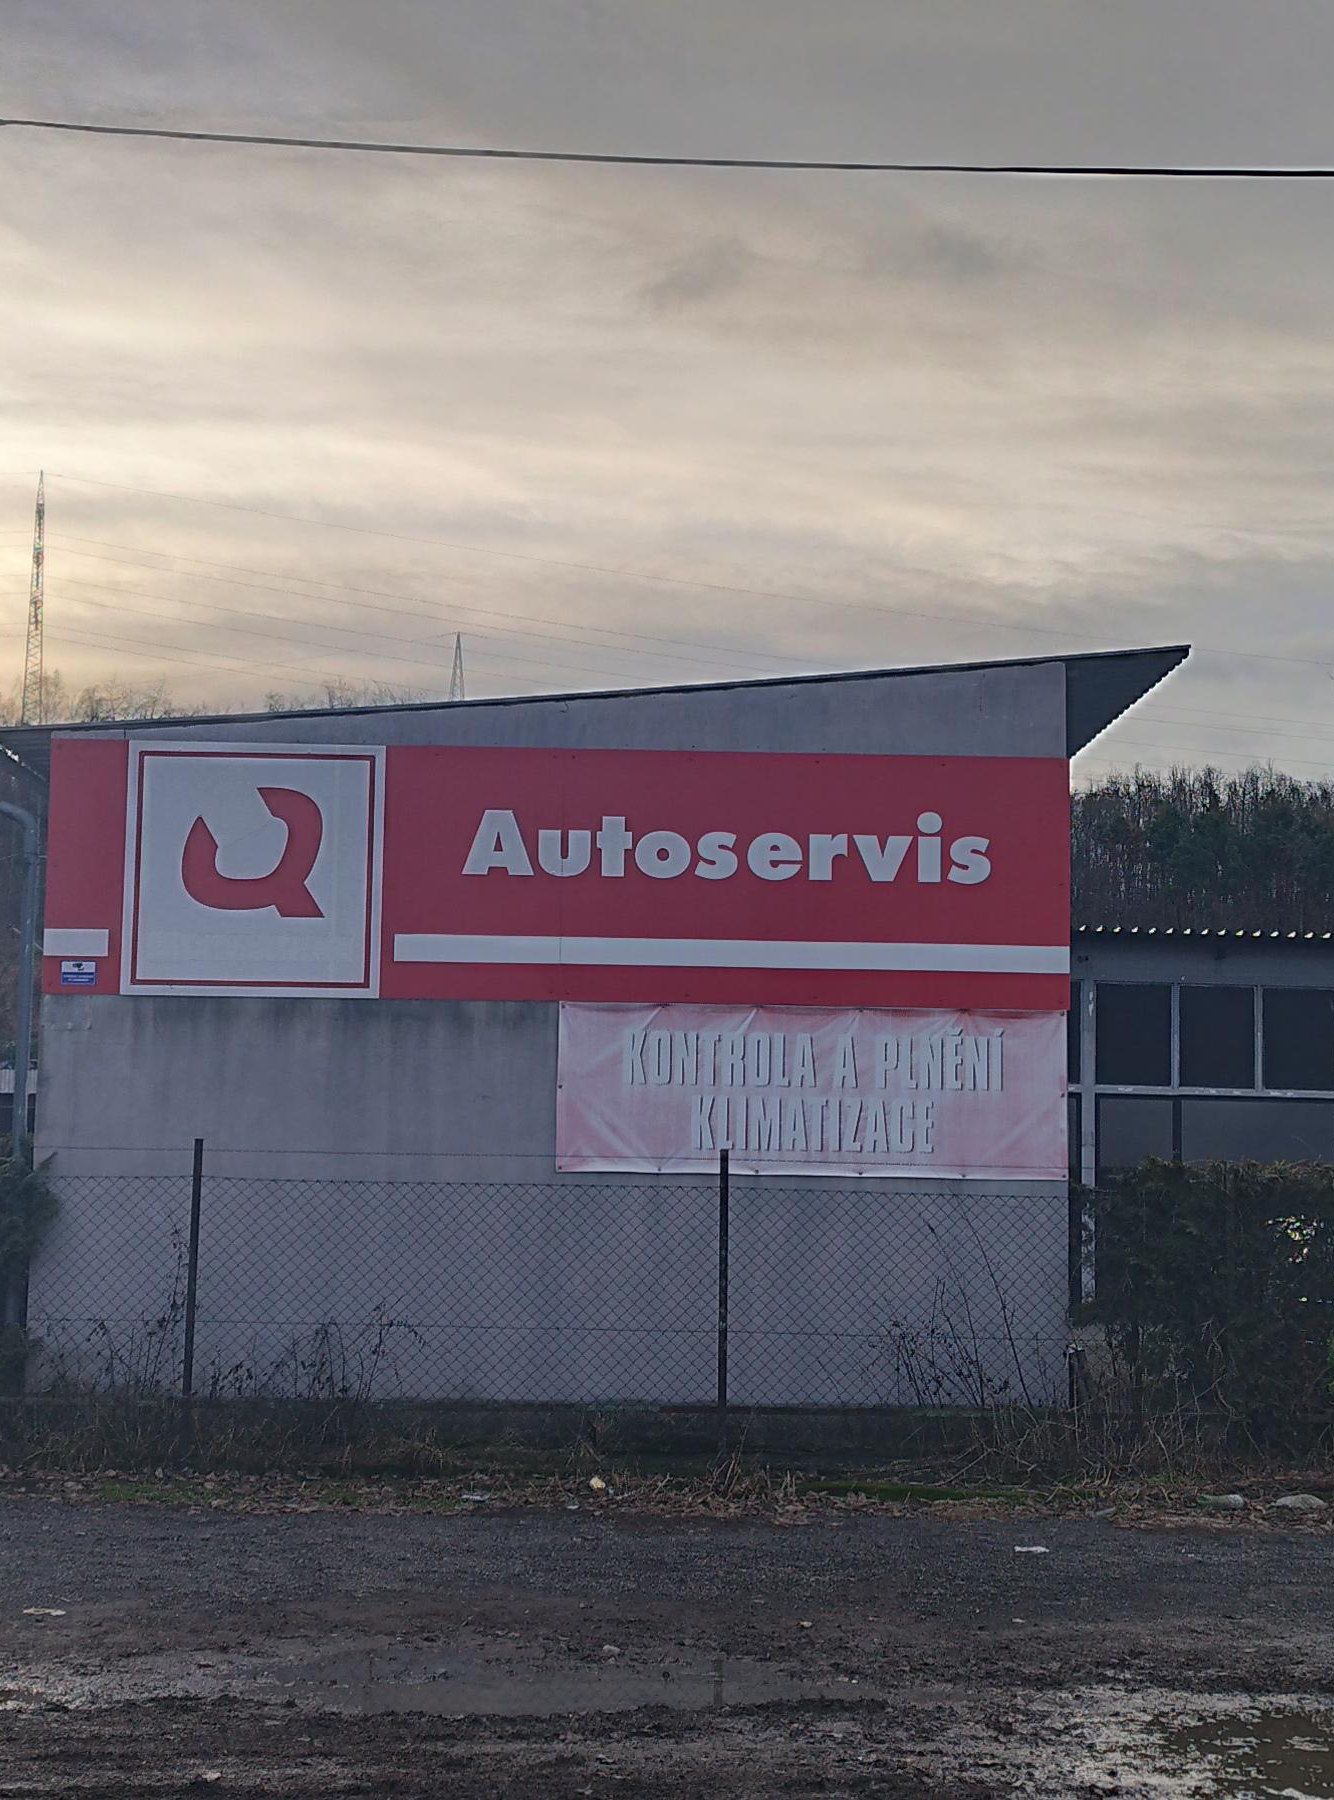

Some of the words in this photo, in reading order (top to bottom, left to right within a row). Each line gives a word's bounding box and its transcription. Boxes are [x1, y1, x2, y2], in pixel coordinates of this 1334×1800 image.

[461, 809, 992, 885] Autoservis
[623, 1030, 817, 1089] KONTROLA
[833, 1032, 859, 1089] A
[875, 1026, 1005, 1092] PLNĚNÍ
[691, 1095, 936, 1154] KLIMATIZACE
